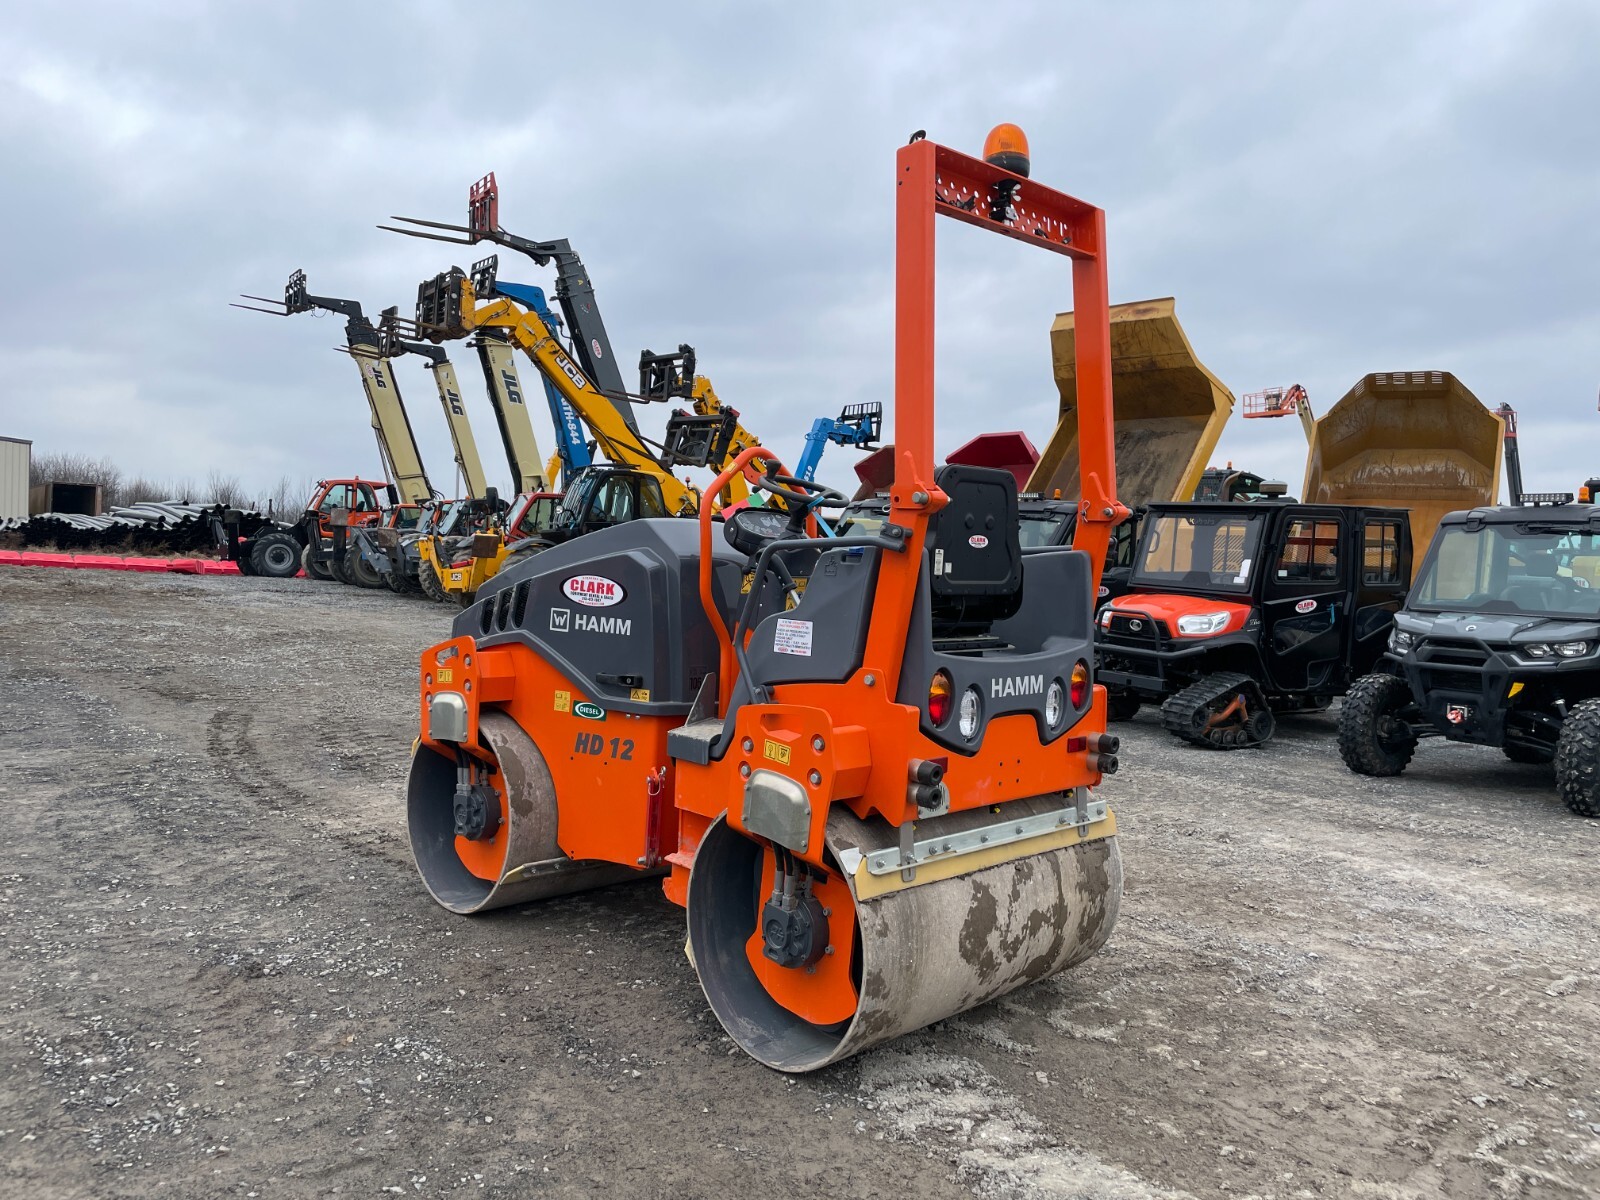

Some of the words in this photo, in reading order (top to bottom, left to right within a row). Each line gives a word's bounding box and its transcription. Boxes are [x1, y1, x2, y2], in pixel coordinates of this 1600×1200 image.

[372, 367, 387, 389] JLG
[556, 354, 586, 389] JCB
[501, 369, 523, 405] JLG
[446, 388, 464, 416] JLG
[451, 573, 462, 581] JCB
[570, 579, 615, 595] CLARK
[575, 614, 631, 636] HAMM
[991, 674, 1044, 699] HAMM
[579, 706, 600, 716] DIESEL
[574, 732, 605, 756] HD
[609, 737, 635, 761] 12
